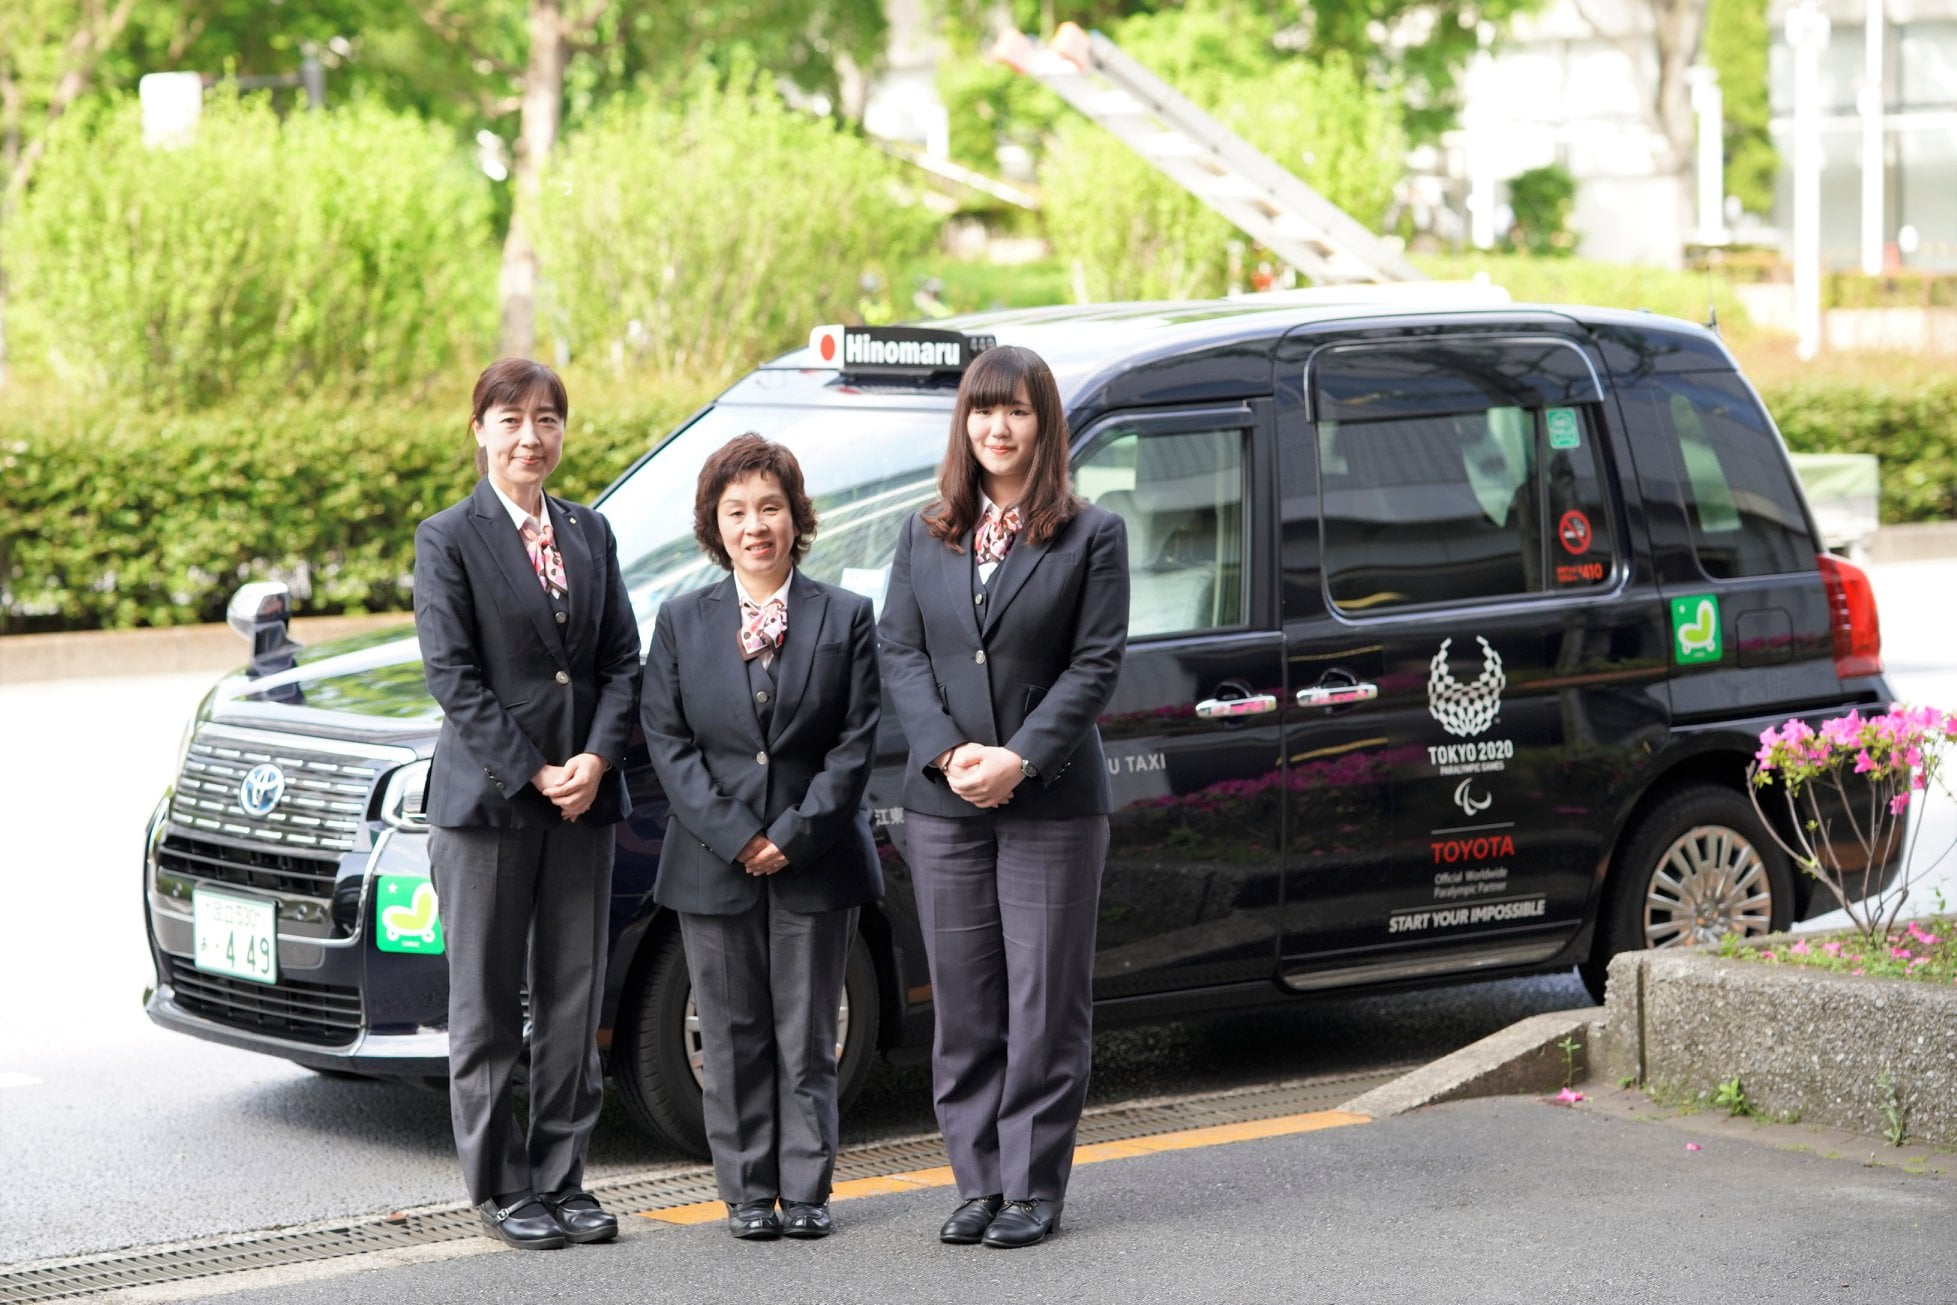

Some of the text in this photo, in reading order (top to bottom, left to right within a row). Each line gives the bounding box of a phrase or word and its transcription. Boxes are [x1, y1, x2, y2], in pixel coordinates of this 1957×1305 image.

[846, 333, 961, 366] Hinomaru
[1125, 752, 1167, 773] TAXI
[1427, 739, 1514, 766] TOKYO 2020
[1431, 835, 1515, 864] TOYOTA
[1434, 866, 1508, 886] Official Worldwide
[1434, 879, 1508, 900] Paralympic Partner
[1389, 899, 1546, 933] START YOUR IMPOSSIBLE
